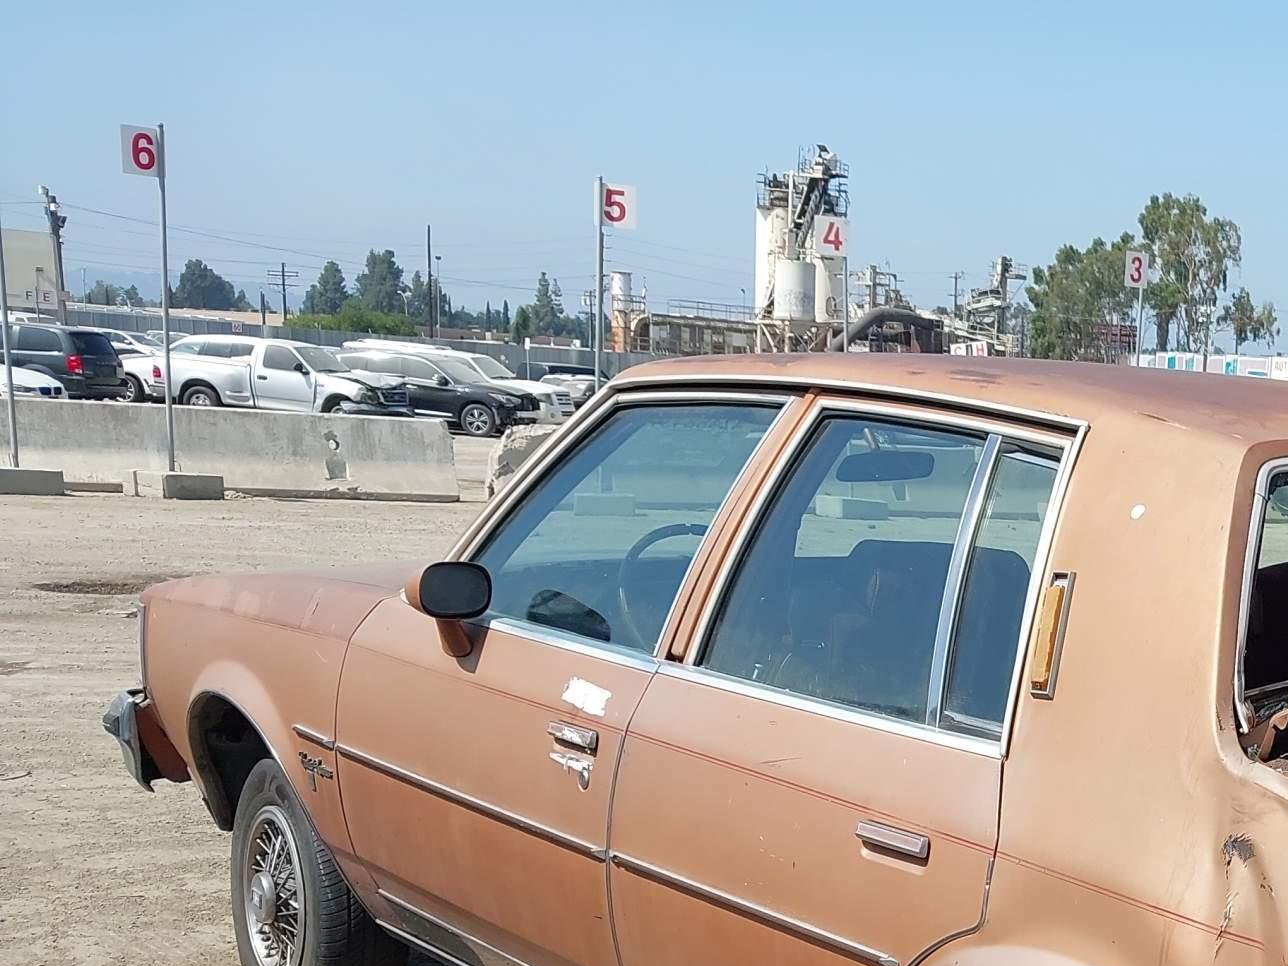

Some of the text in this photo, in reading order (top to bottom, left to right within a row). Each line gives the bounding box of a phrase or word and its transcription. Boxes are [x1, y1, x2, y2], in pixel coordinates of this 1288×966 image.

[132, 132, 155, 170] 6
[604, 189, 626, 222] 5
[823, 222, 843, 251] 4
[1130, 256, 1142, 283] 3
[25, 290, 51, 302] F E
[976, 343, 985, 357] H
